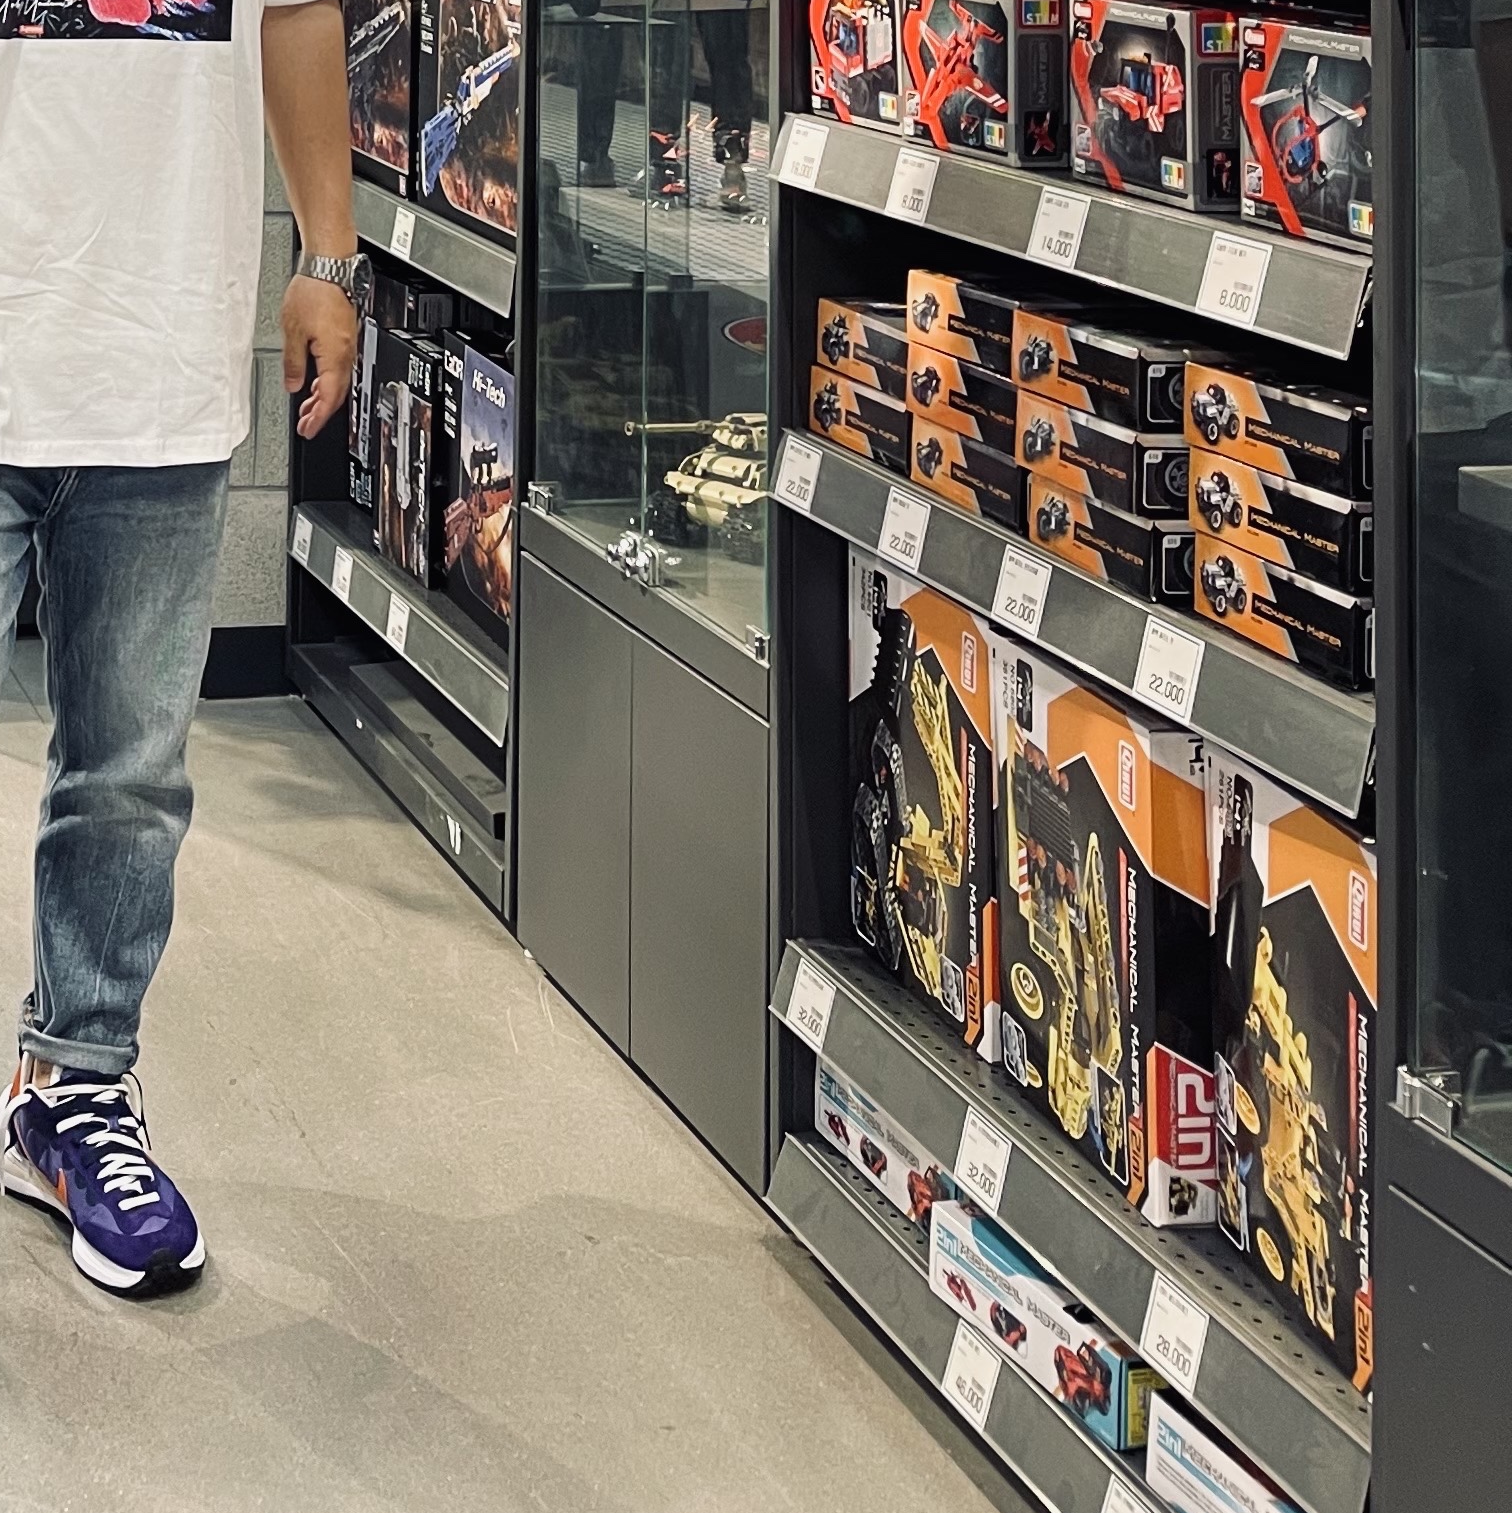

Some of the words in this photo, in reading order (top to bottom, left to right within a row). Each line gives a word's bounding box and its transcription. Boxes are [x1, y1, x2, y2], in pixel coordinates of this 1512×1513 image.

[1221, 70, 1232, 141] MASTER
[1041, 234, 1073, 259] 14,000
[471, 368, 506, 410] Hi-Tech
[1247, 422, 1302, 449] MECHANICAL
[1303, 440, 1341, 462] MASTER
[1250, 511, 1303, 540] MECHANICAL
[1303, 531, 1340, 554] MASTER
[1254, 599, 1305, 632] MECHANICAL
[1305, 623, 1342, 649] MASTER
[1148, 673, 1185, 706] 22,000
[966, 743, 977, 874] MECHANICAL
[966, 882, 979, 968] MASTER
[1126, 866, 1138, 1013] MECHANICAL
[1129, 1023, 1141, 1119] MASTER
[1357, 1013, 1369, 1178] MECHANICAL
[1358, 1187, 1371, 1294] MASTER
[959, 1239, 1024, 1307] MECHANICAL
[1026, 1295, 1072, 1345] MASTER
